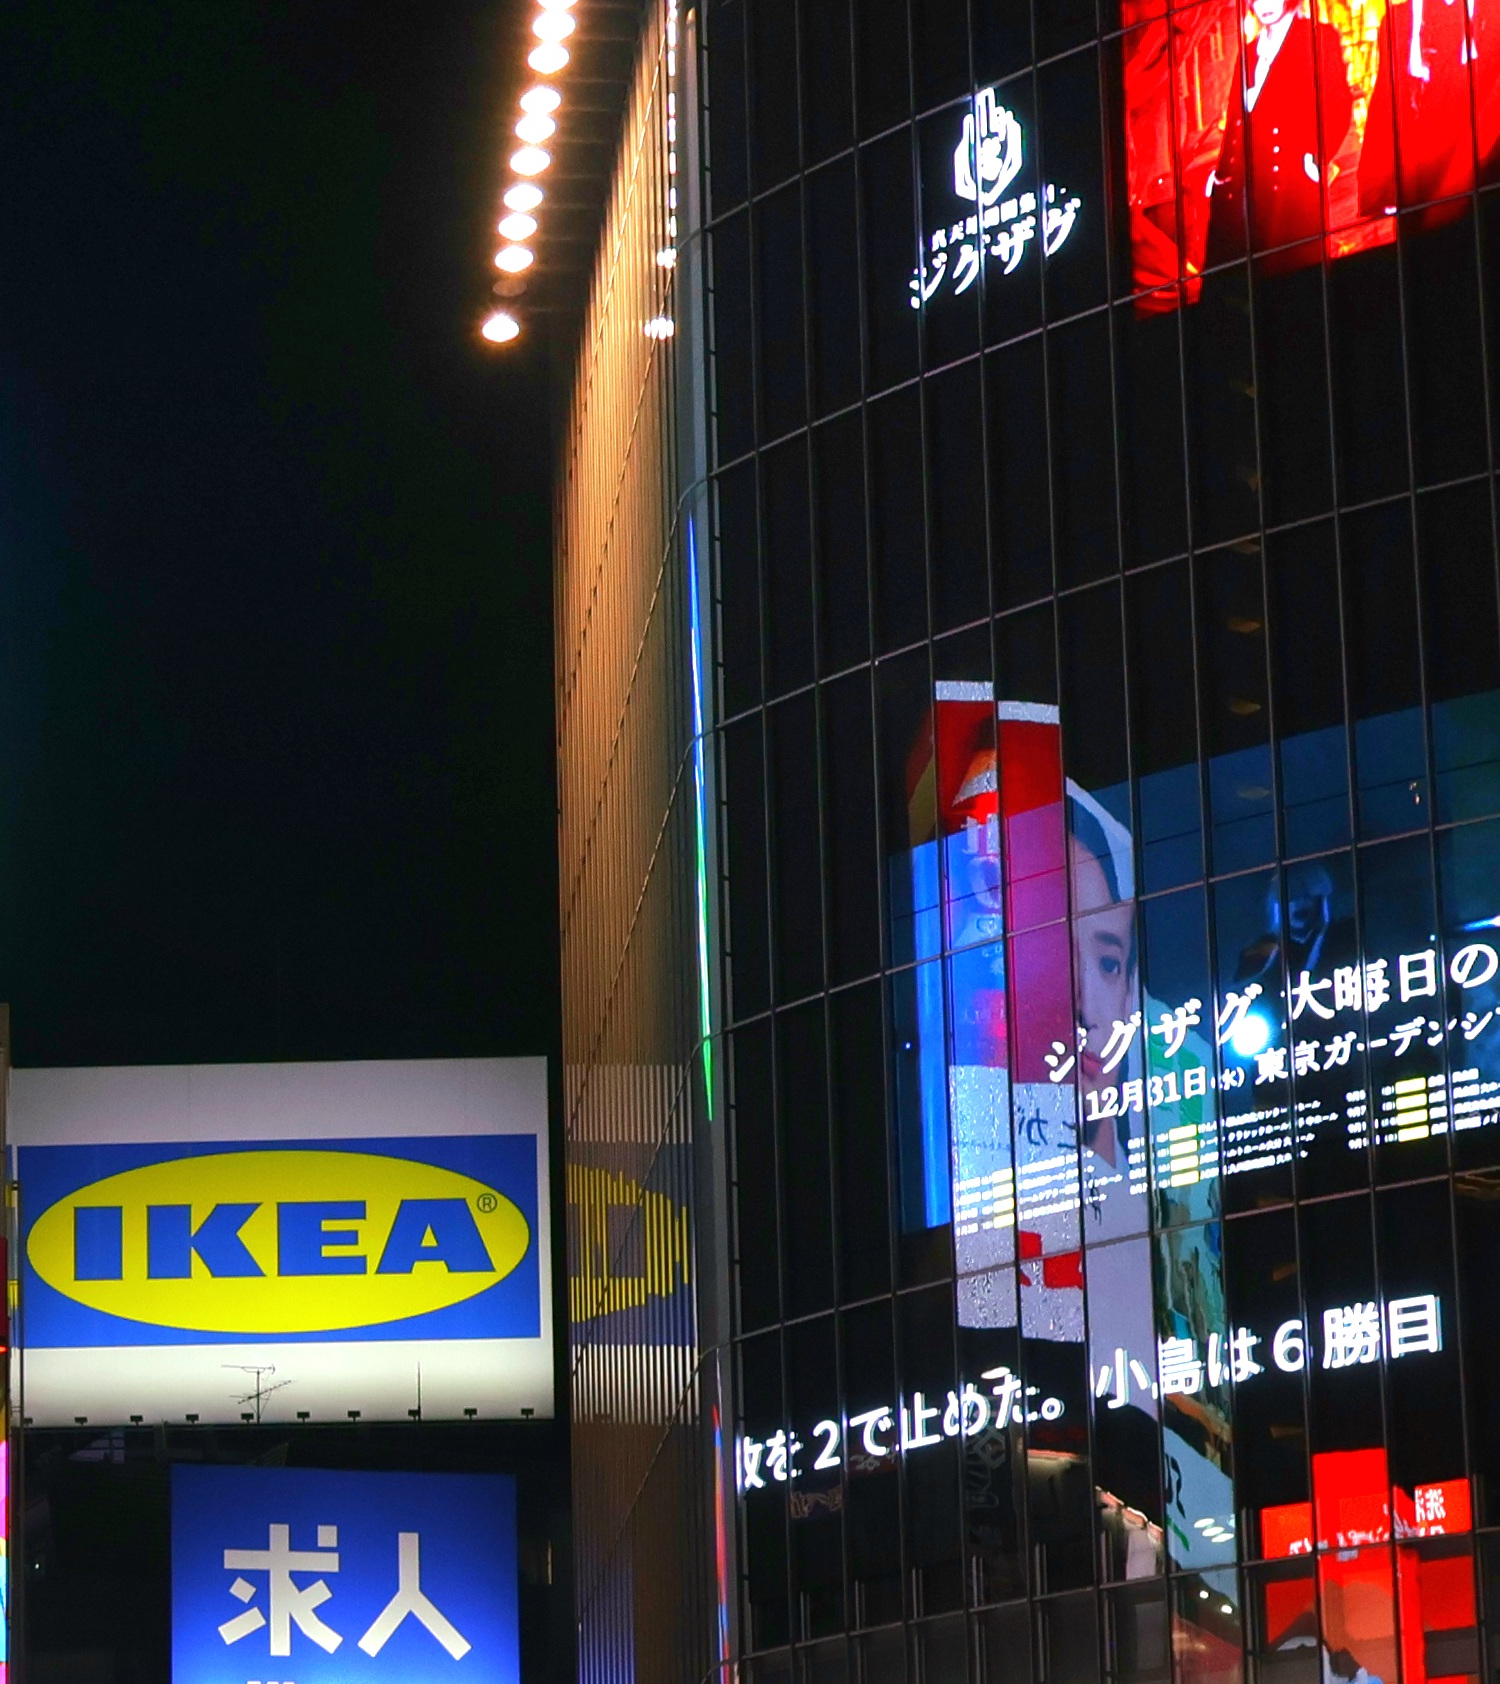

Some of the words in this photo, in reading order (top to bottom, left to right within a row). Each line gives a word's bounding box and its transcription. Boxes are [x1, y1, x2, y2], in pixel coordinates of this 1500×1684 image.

[909, 196, 1081, 310] ジグザグ
[73, 1197, 497, 1282] IKEA
[1094, 1293, 1444, 1410] 小島は6勝目
[218, 1523, 472, 1661] 求人
